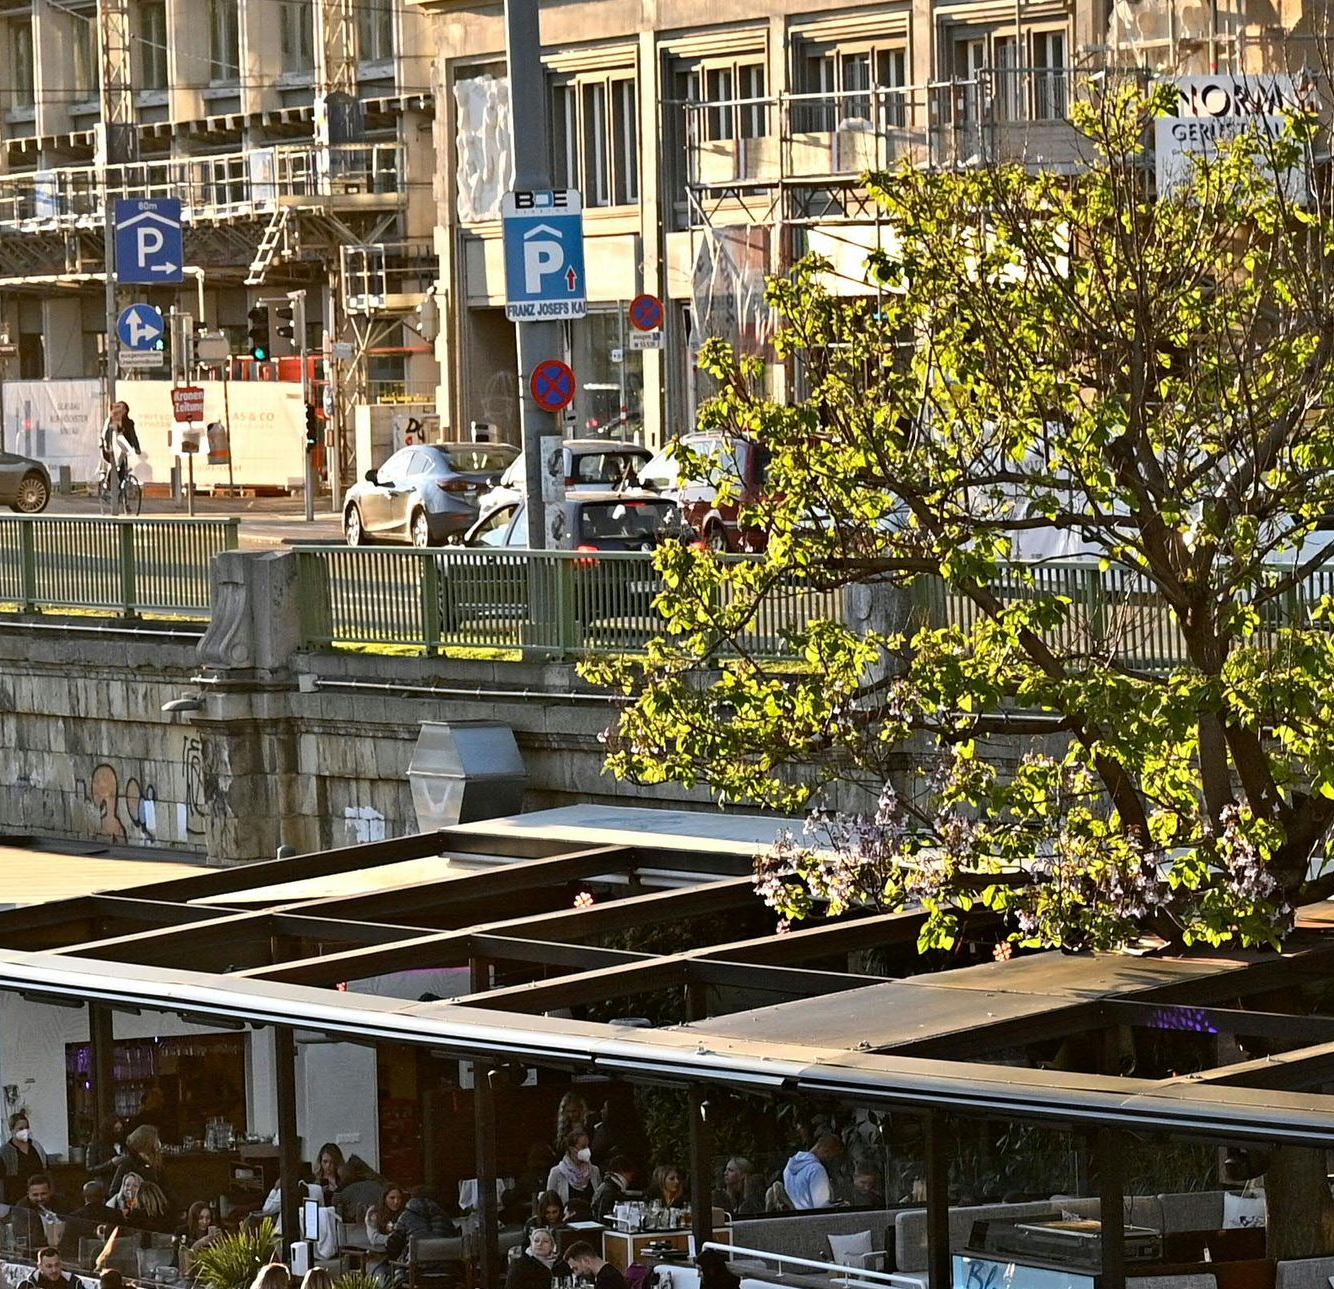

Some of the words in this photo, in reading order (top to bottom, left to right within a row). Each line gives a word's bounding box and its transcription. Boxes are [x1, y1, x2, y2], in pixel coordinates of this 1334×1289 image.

[137, 227, 164, 268] P
[523, 240, 565, 294] P
[506, 303, 536, 317] FRANZ
[537, 301, 570, 316] JOSEFS
[173, 390, 205, 402] Kronen
